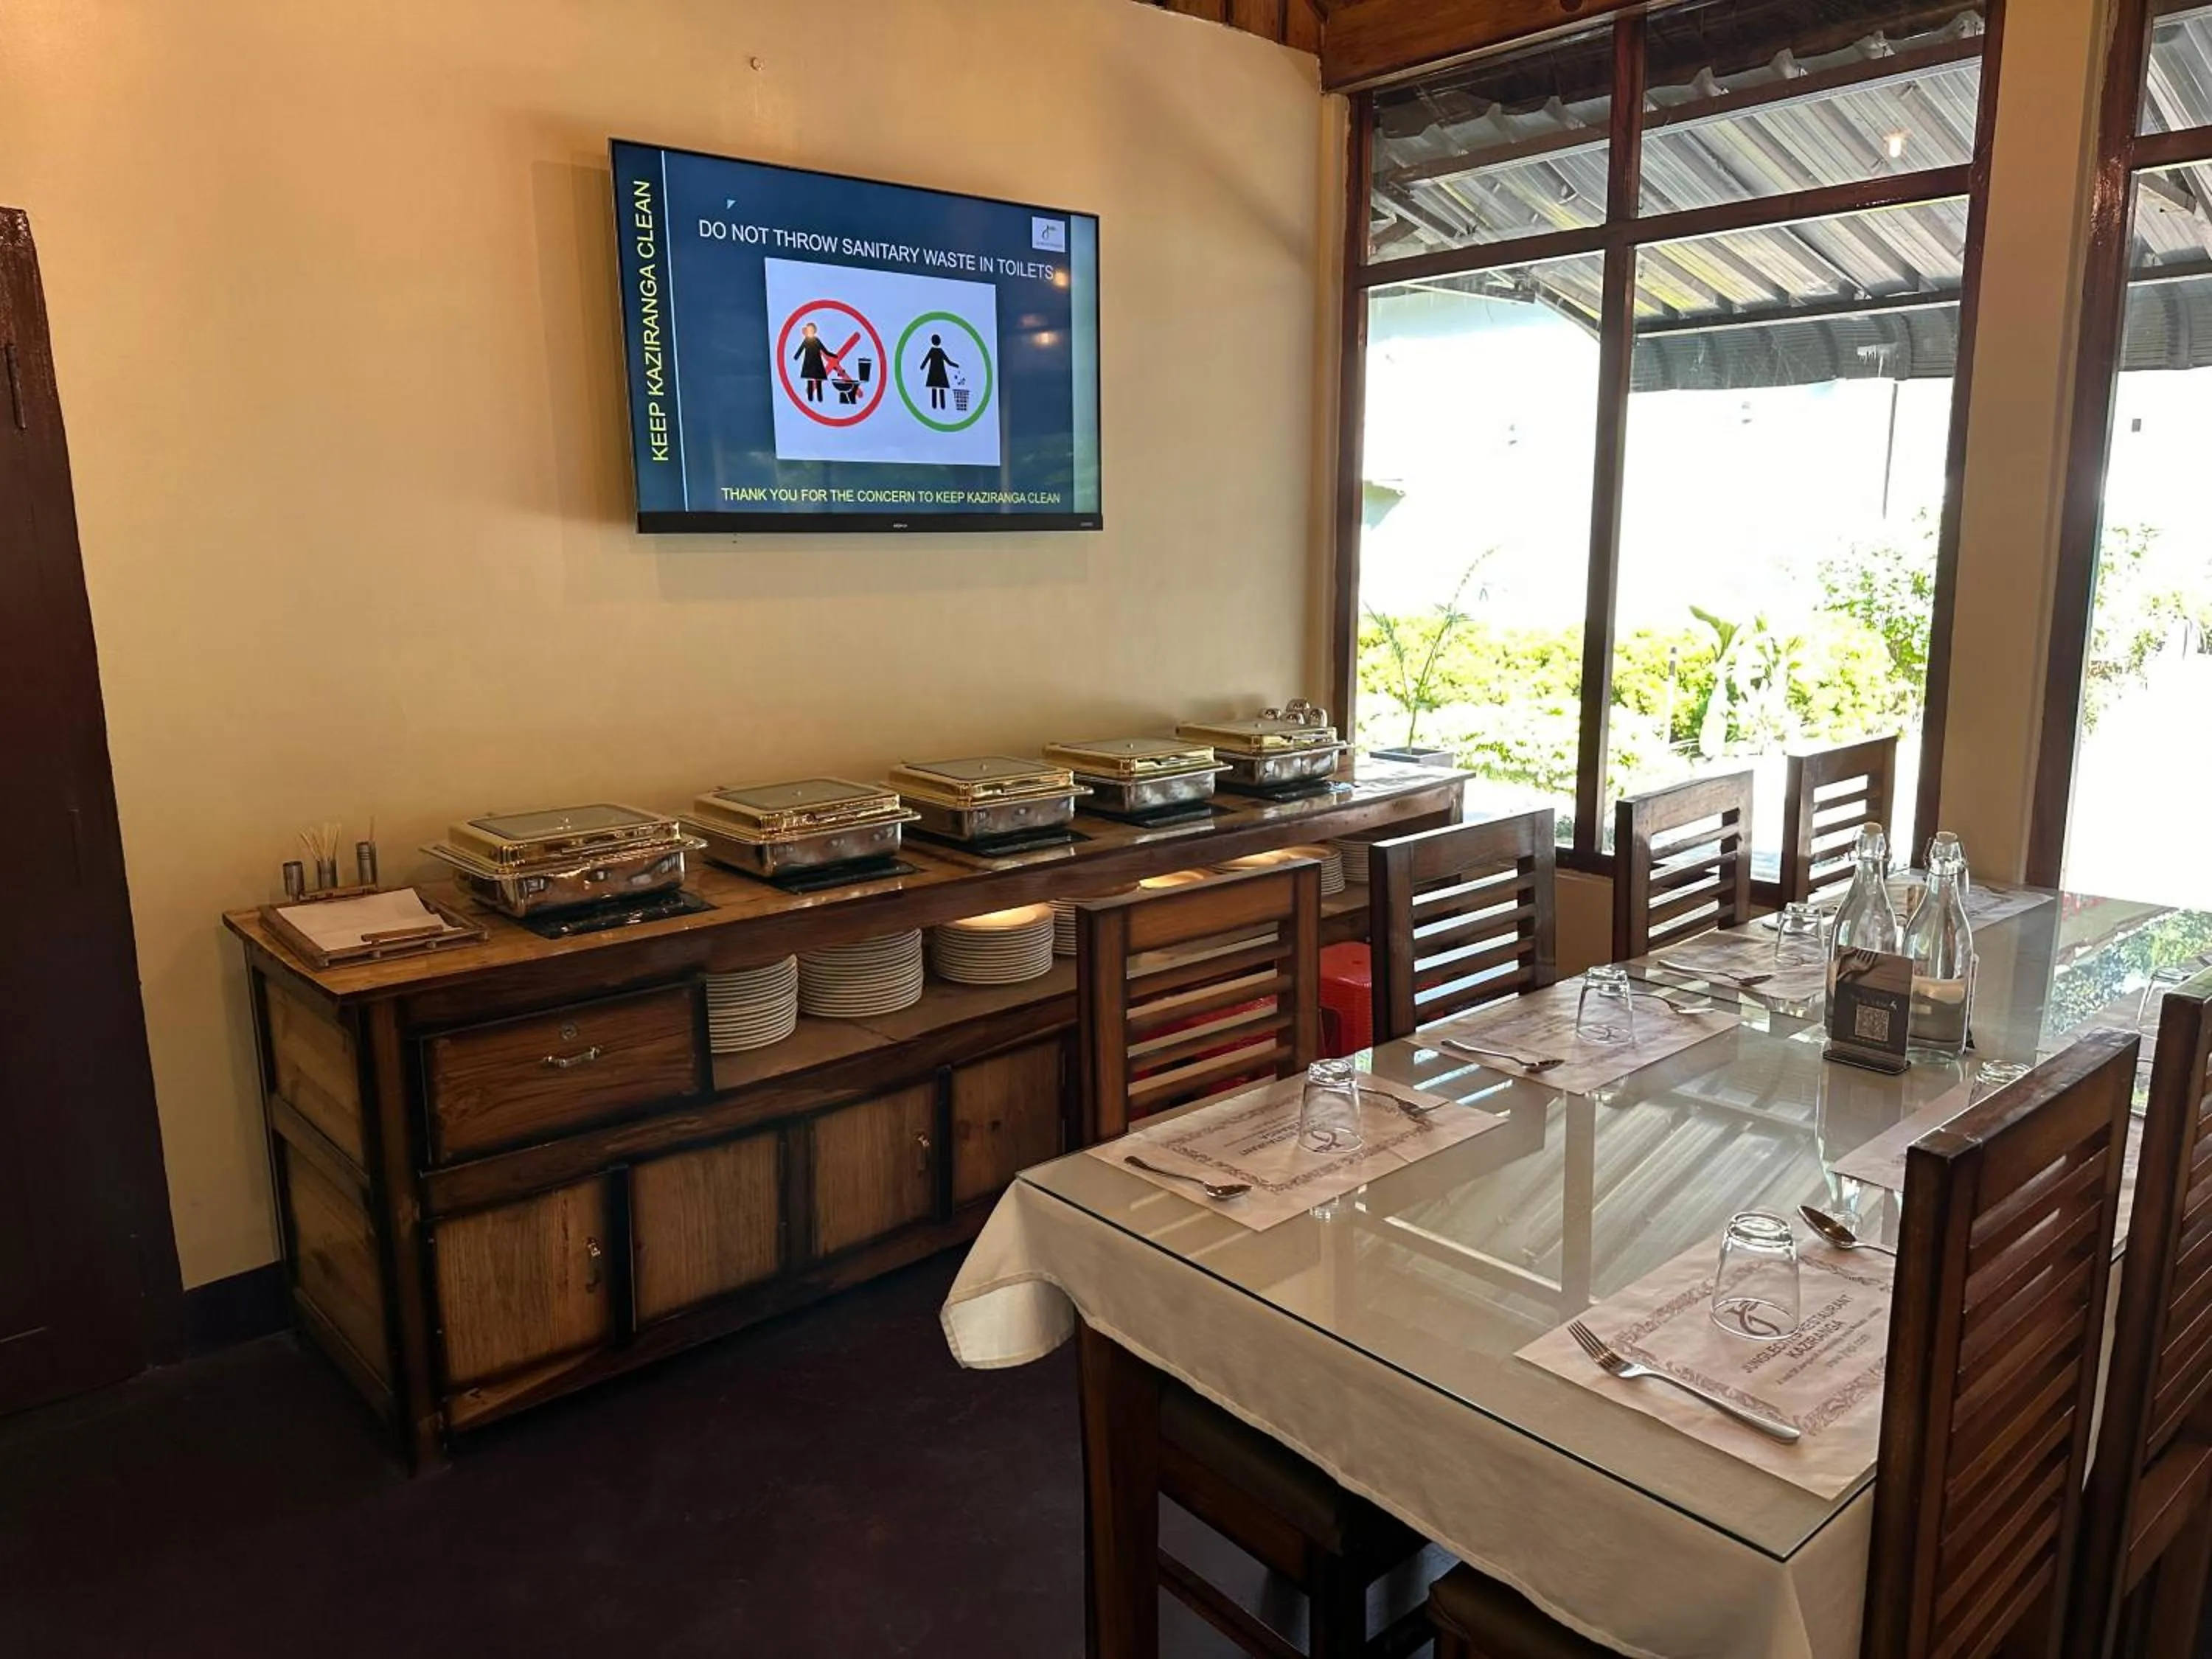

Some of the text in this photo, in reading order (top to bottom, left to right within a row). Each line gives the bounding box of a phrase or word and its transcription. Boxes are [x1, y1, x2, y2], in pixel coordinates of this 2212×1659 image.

[699, 220, 1054, 279] DO NOT THROW SANITARY WASTE IN TOILETS
[633, 180, 669, 462] KEEP KAZIRANGA CLEAN
[721, 487, 1061, 504] THANK YOU FOR THE CONCERN TO KEEP KAZIRANGA CLEAN
[1785, 1319, 1845, 1359] KAZIRANGA
